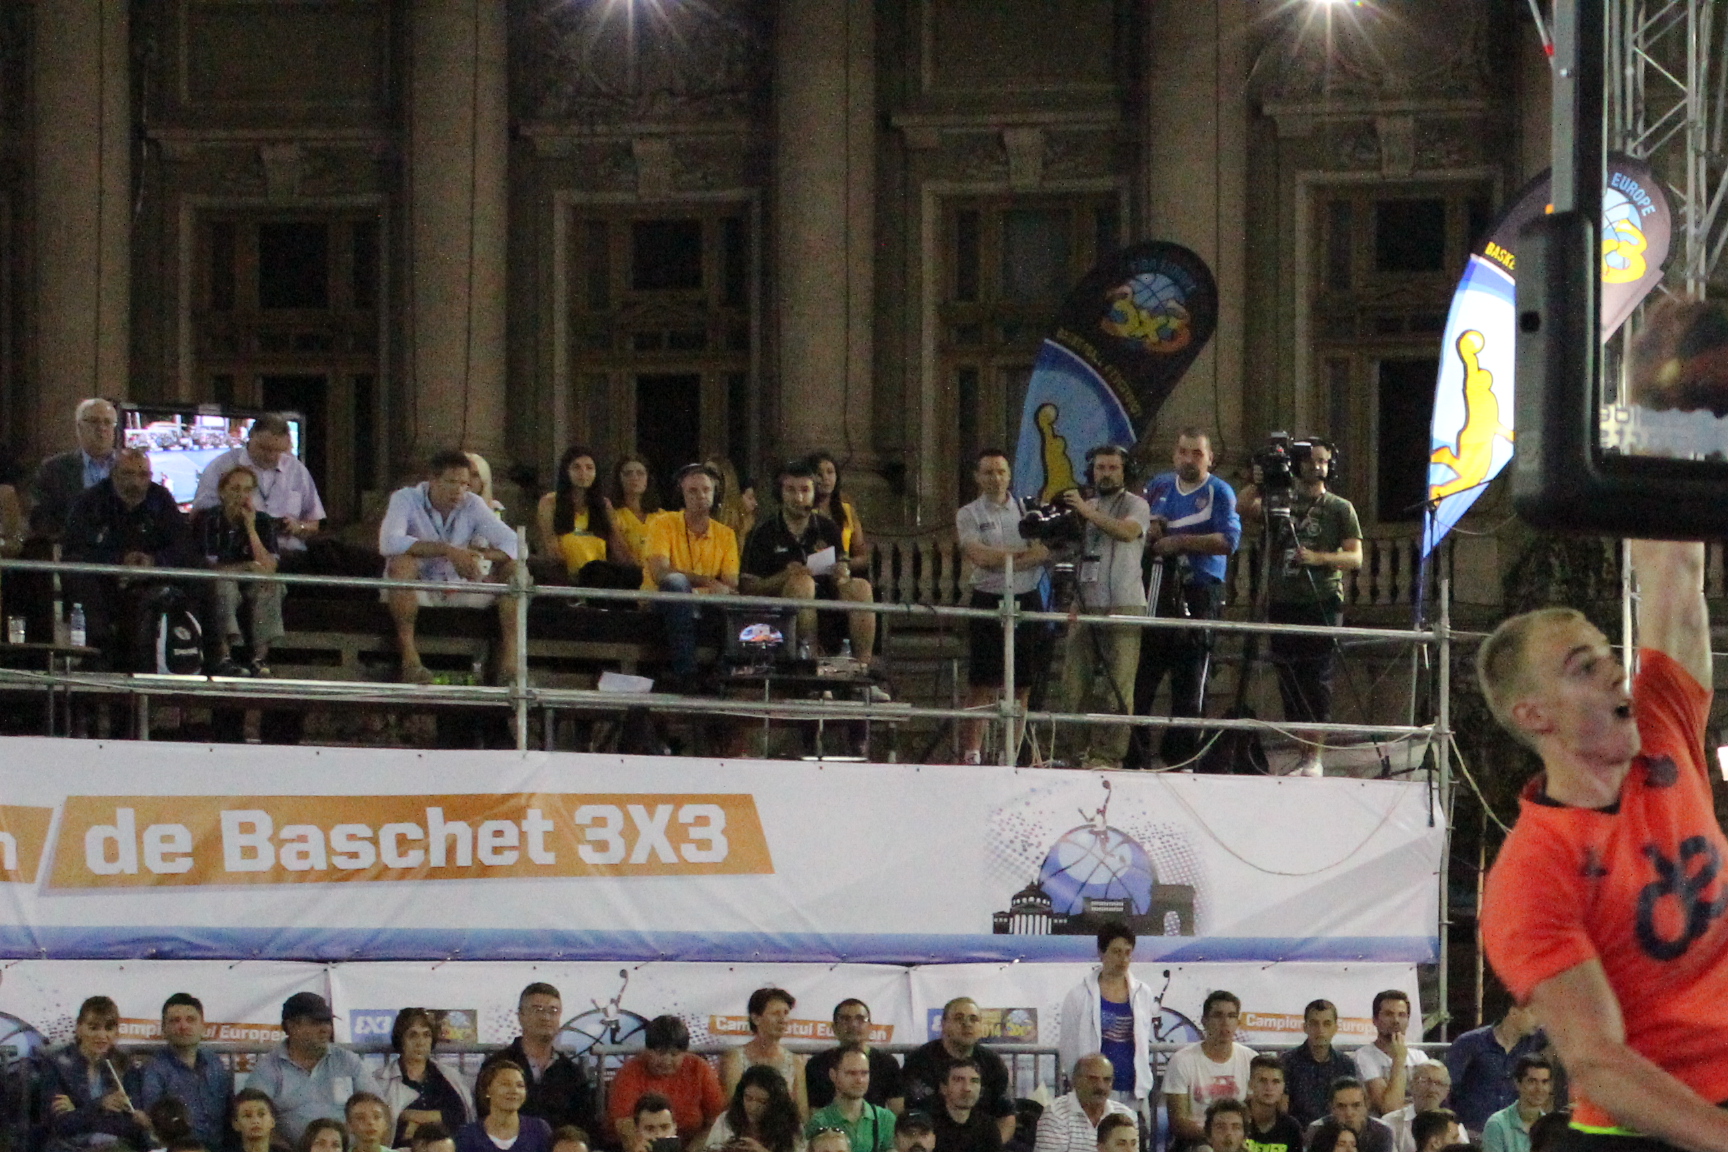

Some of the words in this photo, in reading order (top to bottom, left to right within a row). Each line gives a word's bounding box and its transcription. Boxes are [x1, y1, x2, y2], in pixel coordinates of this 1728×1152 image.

[1611, 172, 1656, 217] EUROPE
[1485, 241, 1517, 270] BASKE
[85, 808, 194, 875] de
[221, 806, 556, 873] Baschet
[577, 804, 728, 865] 3X3
[220, 1025, 288, 1042] Europe
